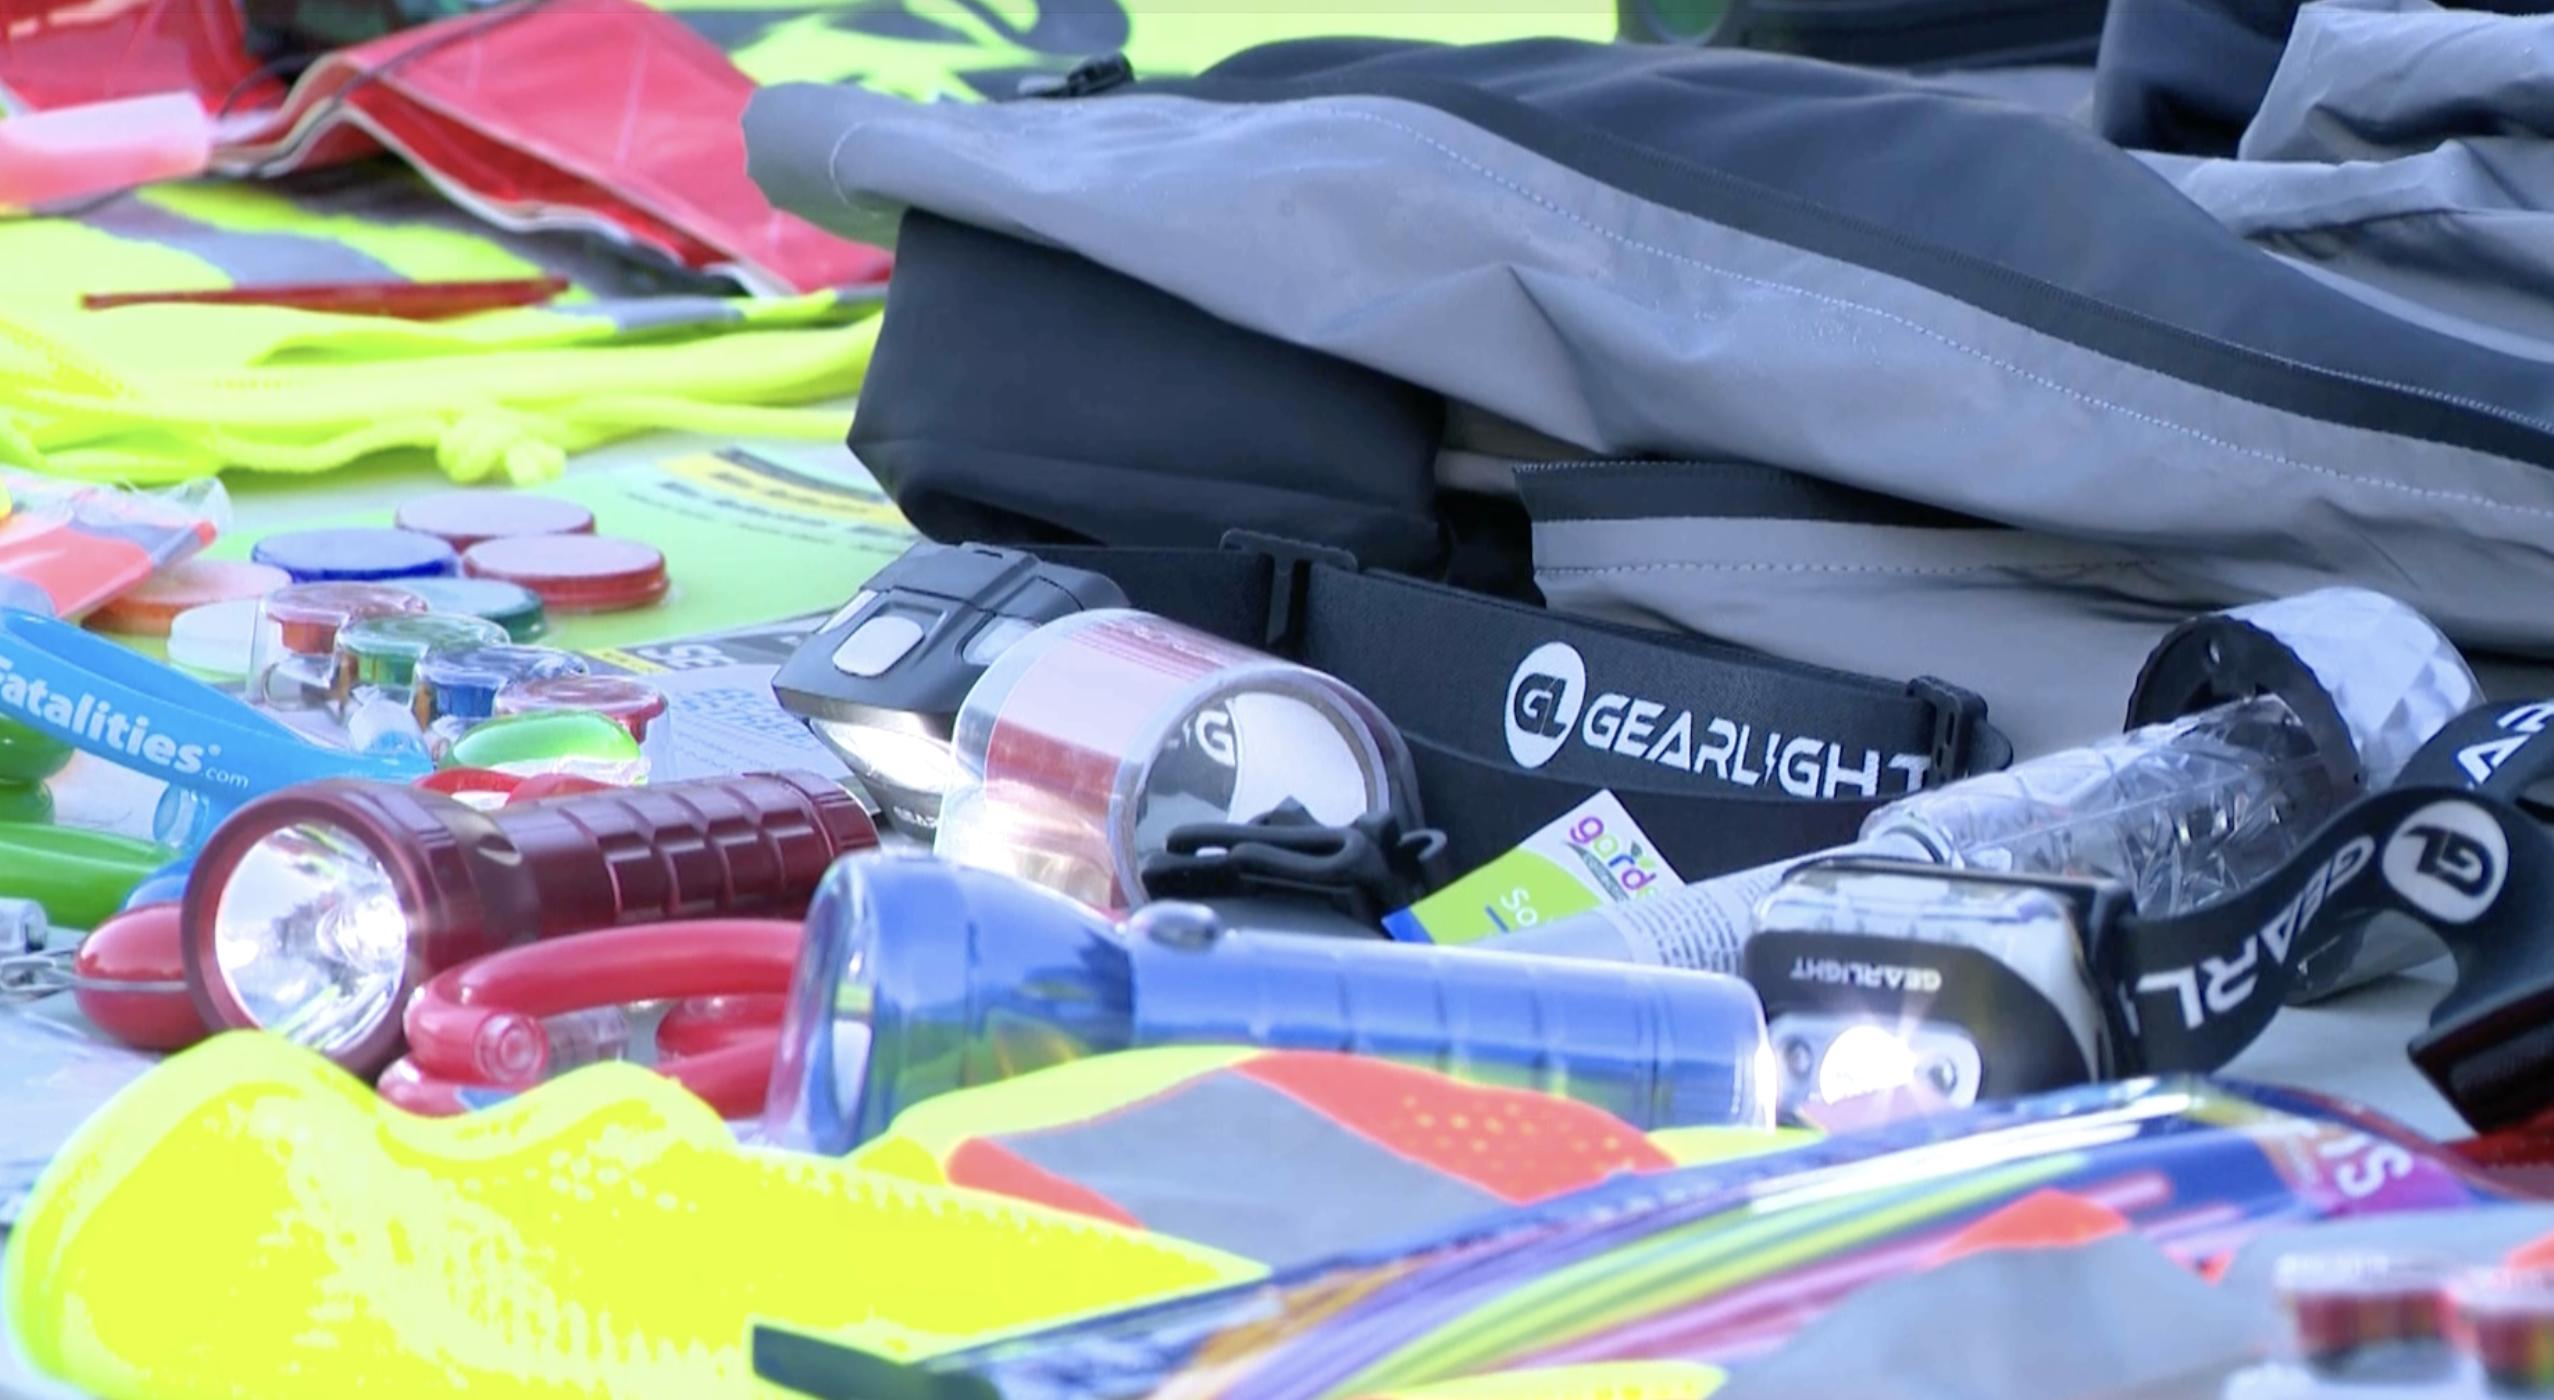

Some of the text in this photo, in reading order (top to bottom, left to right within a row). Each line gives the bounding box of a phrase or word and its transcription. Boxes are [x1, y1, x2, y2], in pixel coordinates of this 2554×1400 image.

[1514, 672, 1932, 799] GL GEARLIGHT
[2401, 825, 2495, 897] GL
[1789, 957, 1942, 992] GEARLIGHT
